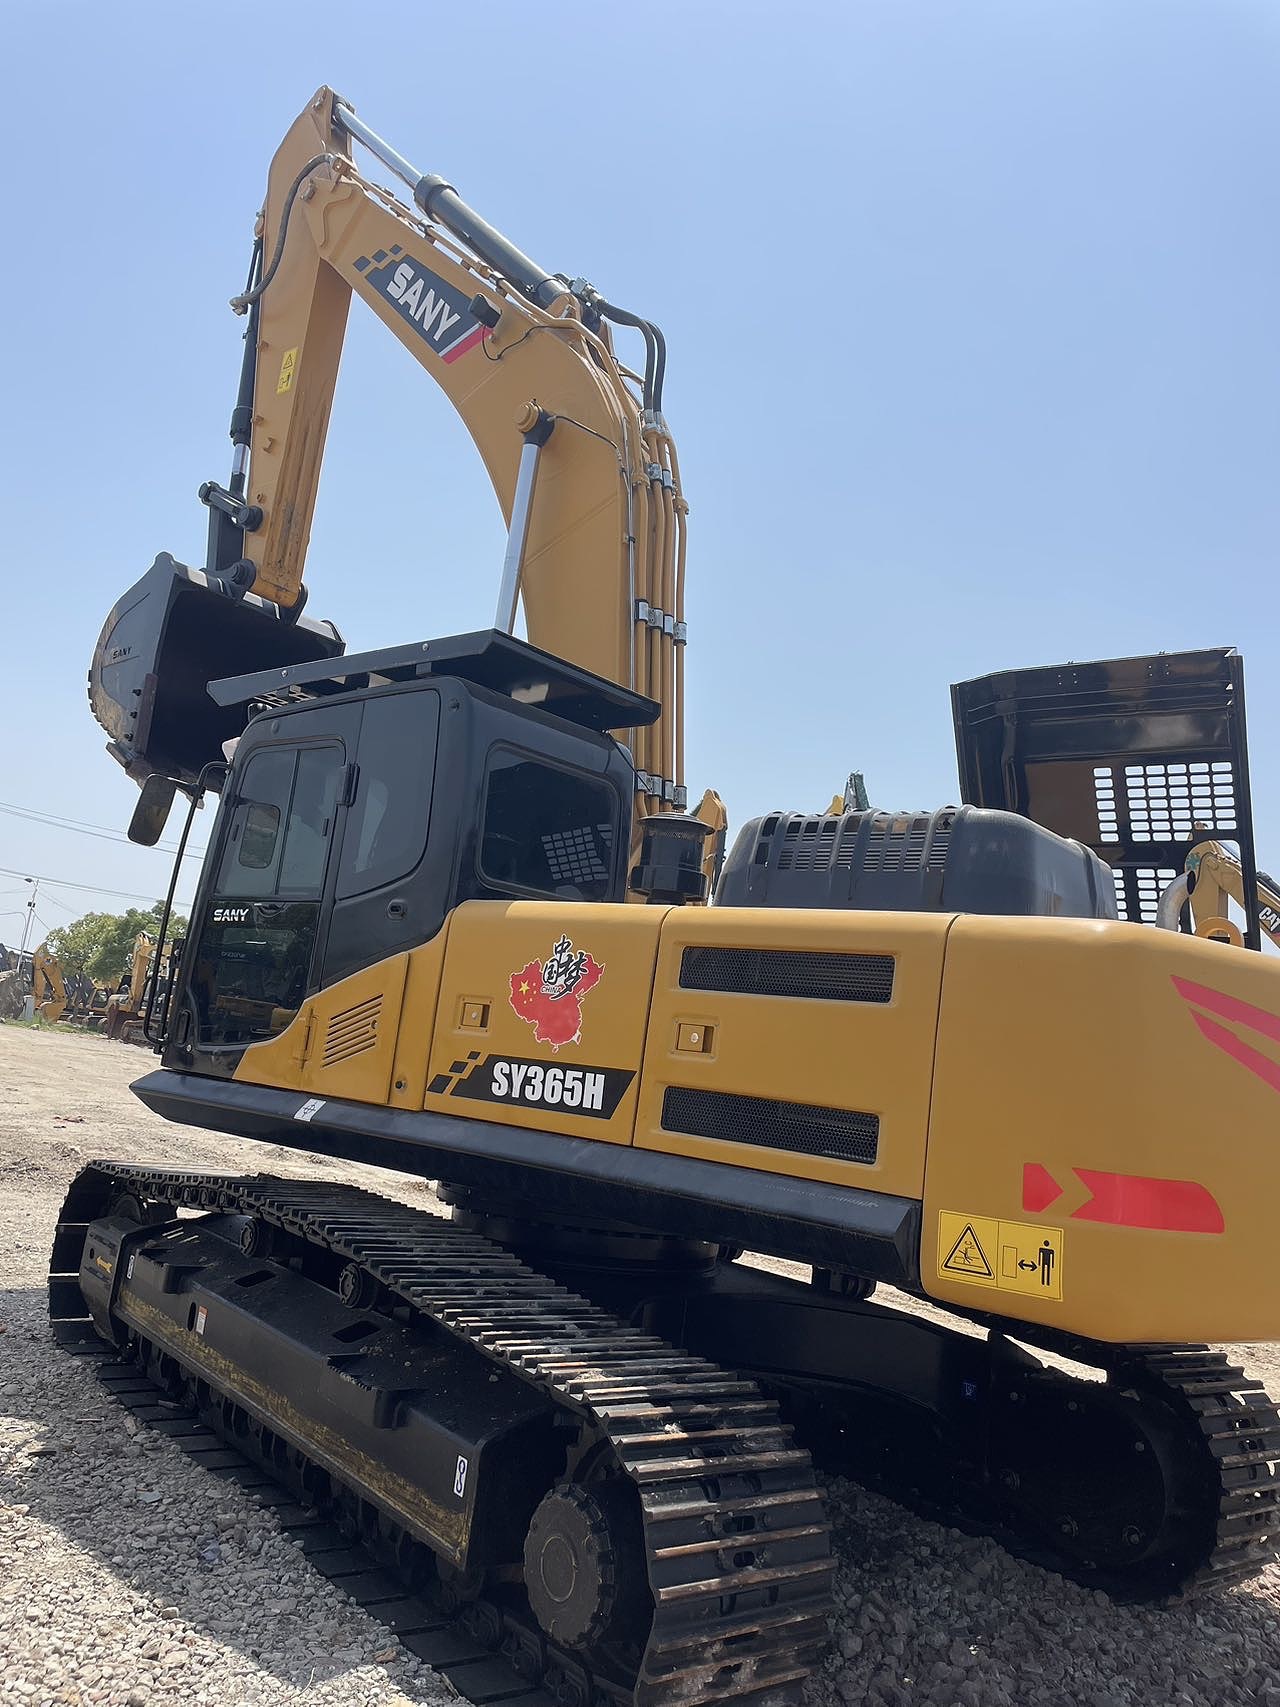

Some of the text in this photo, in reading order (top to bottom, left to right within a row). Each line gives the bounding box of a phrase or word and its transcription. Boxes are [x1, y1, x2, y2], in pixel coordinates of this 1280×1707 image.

[386, 262, 461, 342] SANY
[112, 645, 133, 660] SANY
[213, 908, 249, 922] SANY
[491, 1061, 606, 1111] SY365H
